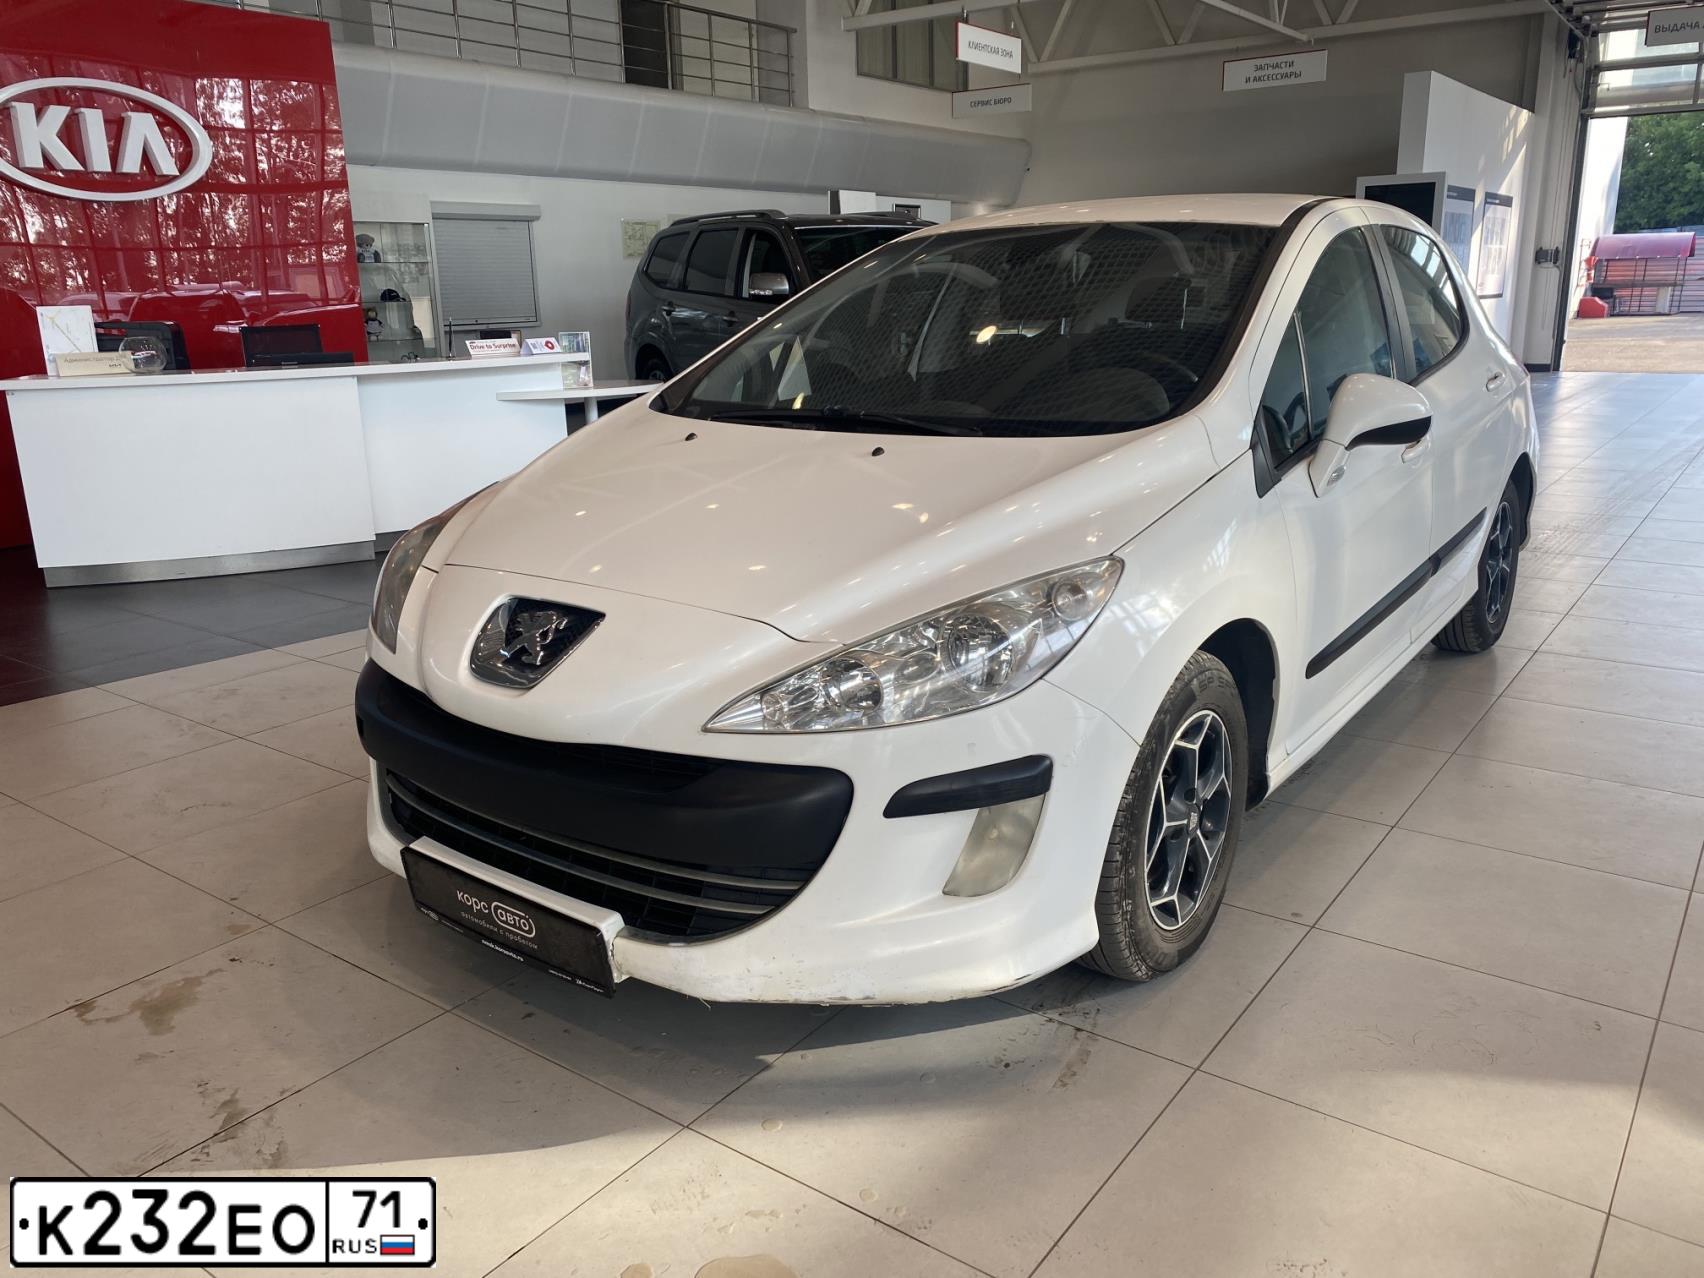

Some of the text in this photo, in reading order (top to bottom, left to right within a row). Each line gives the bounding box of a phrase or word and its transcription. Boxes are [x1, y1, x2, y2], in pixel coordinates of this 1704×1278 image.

[1654, 21, 1700, 33] ВЫДАЧА
[968, 40, 1014, 60] КЛИЕНТСКАЯ ЗОНА
[1253, 60, 1295, 72] ЗАПЧАСТИ
[1245, 70, 1302, 84] И АКСЕССУАРЫ
[969, 96, 1012, 109] СЕРВИС БЮРО
[8, 101, 180, 176] KIA
[456, 889, 529, 931] корс авто
